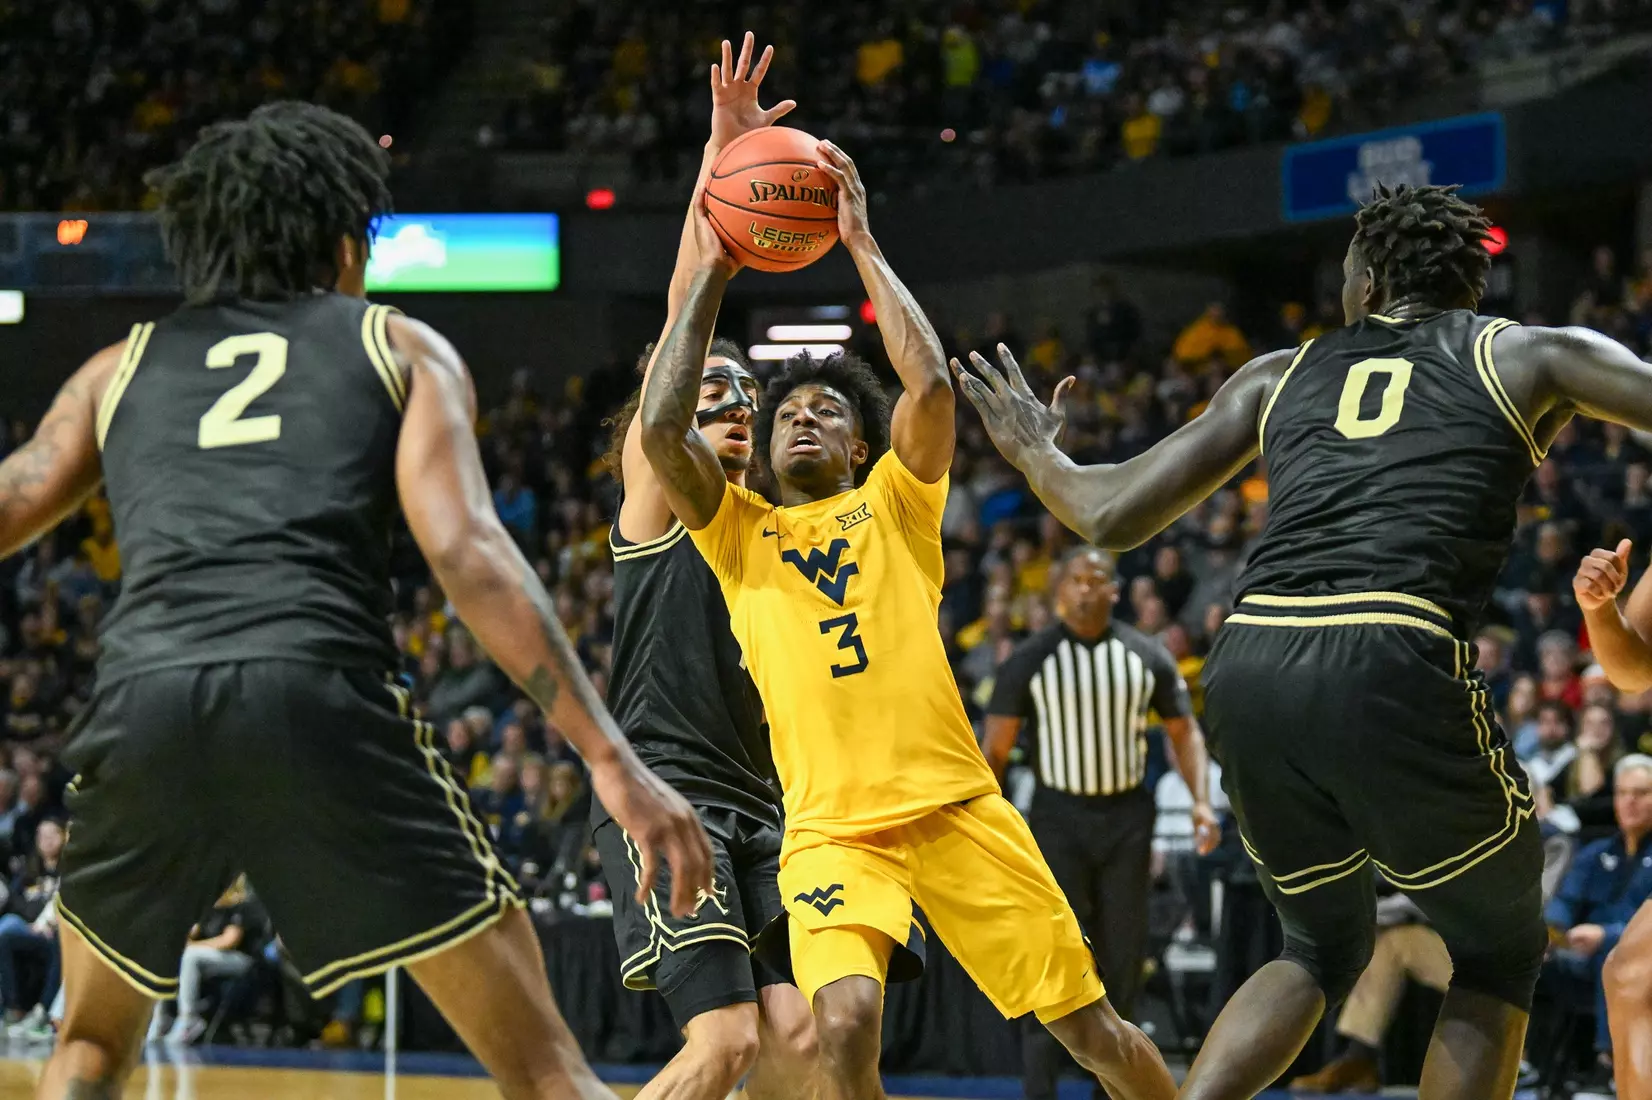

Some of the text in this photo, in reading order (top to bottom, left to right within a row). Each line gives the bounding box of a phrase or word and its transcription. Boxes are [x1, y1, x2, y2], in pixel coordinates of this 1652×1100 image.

[748, 220, 830, 245] LEGACY
[198, 332, 289, 449] 2
[1333, 357, 1414, 439] 0
[819, 612, 869, 679] 3
